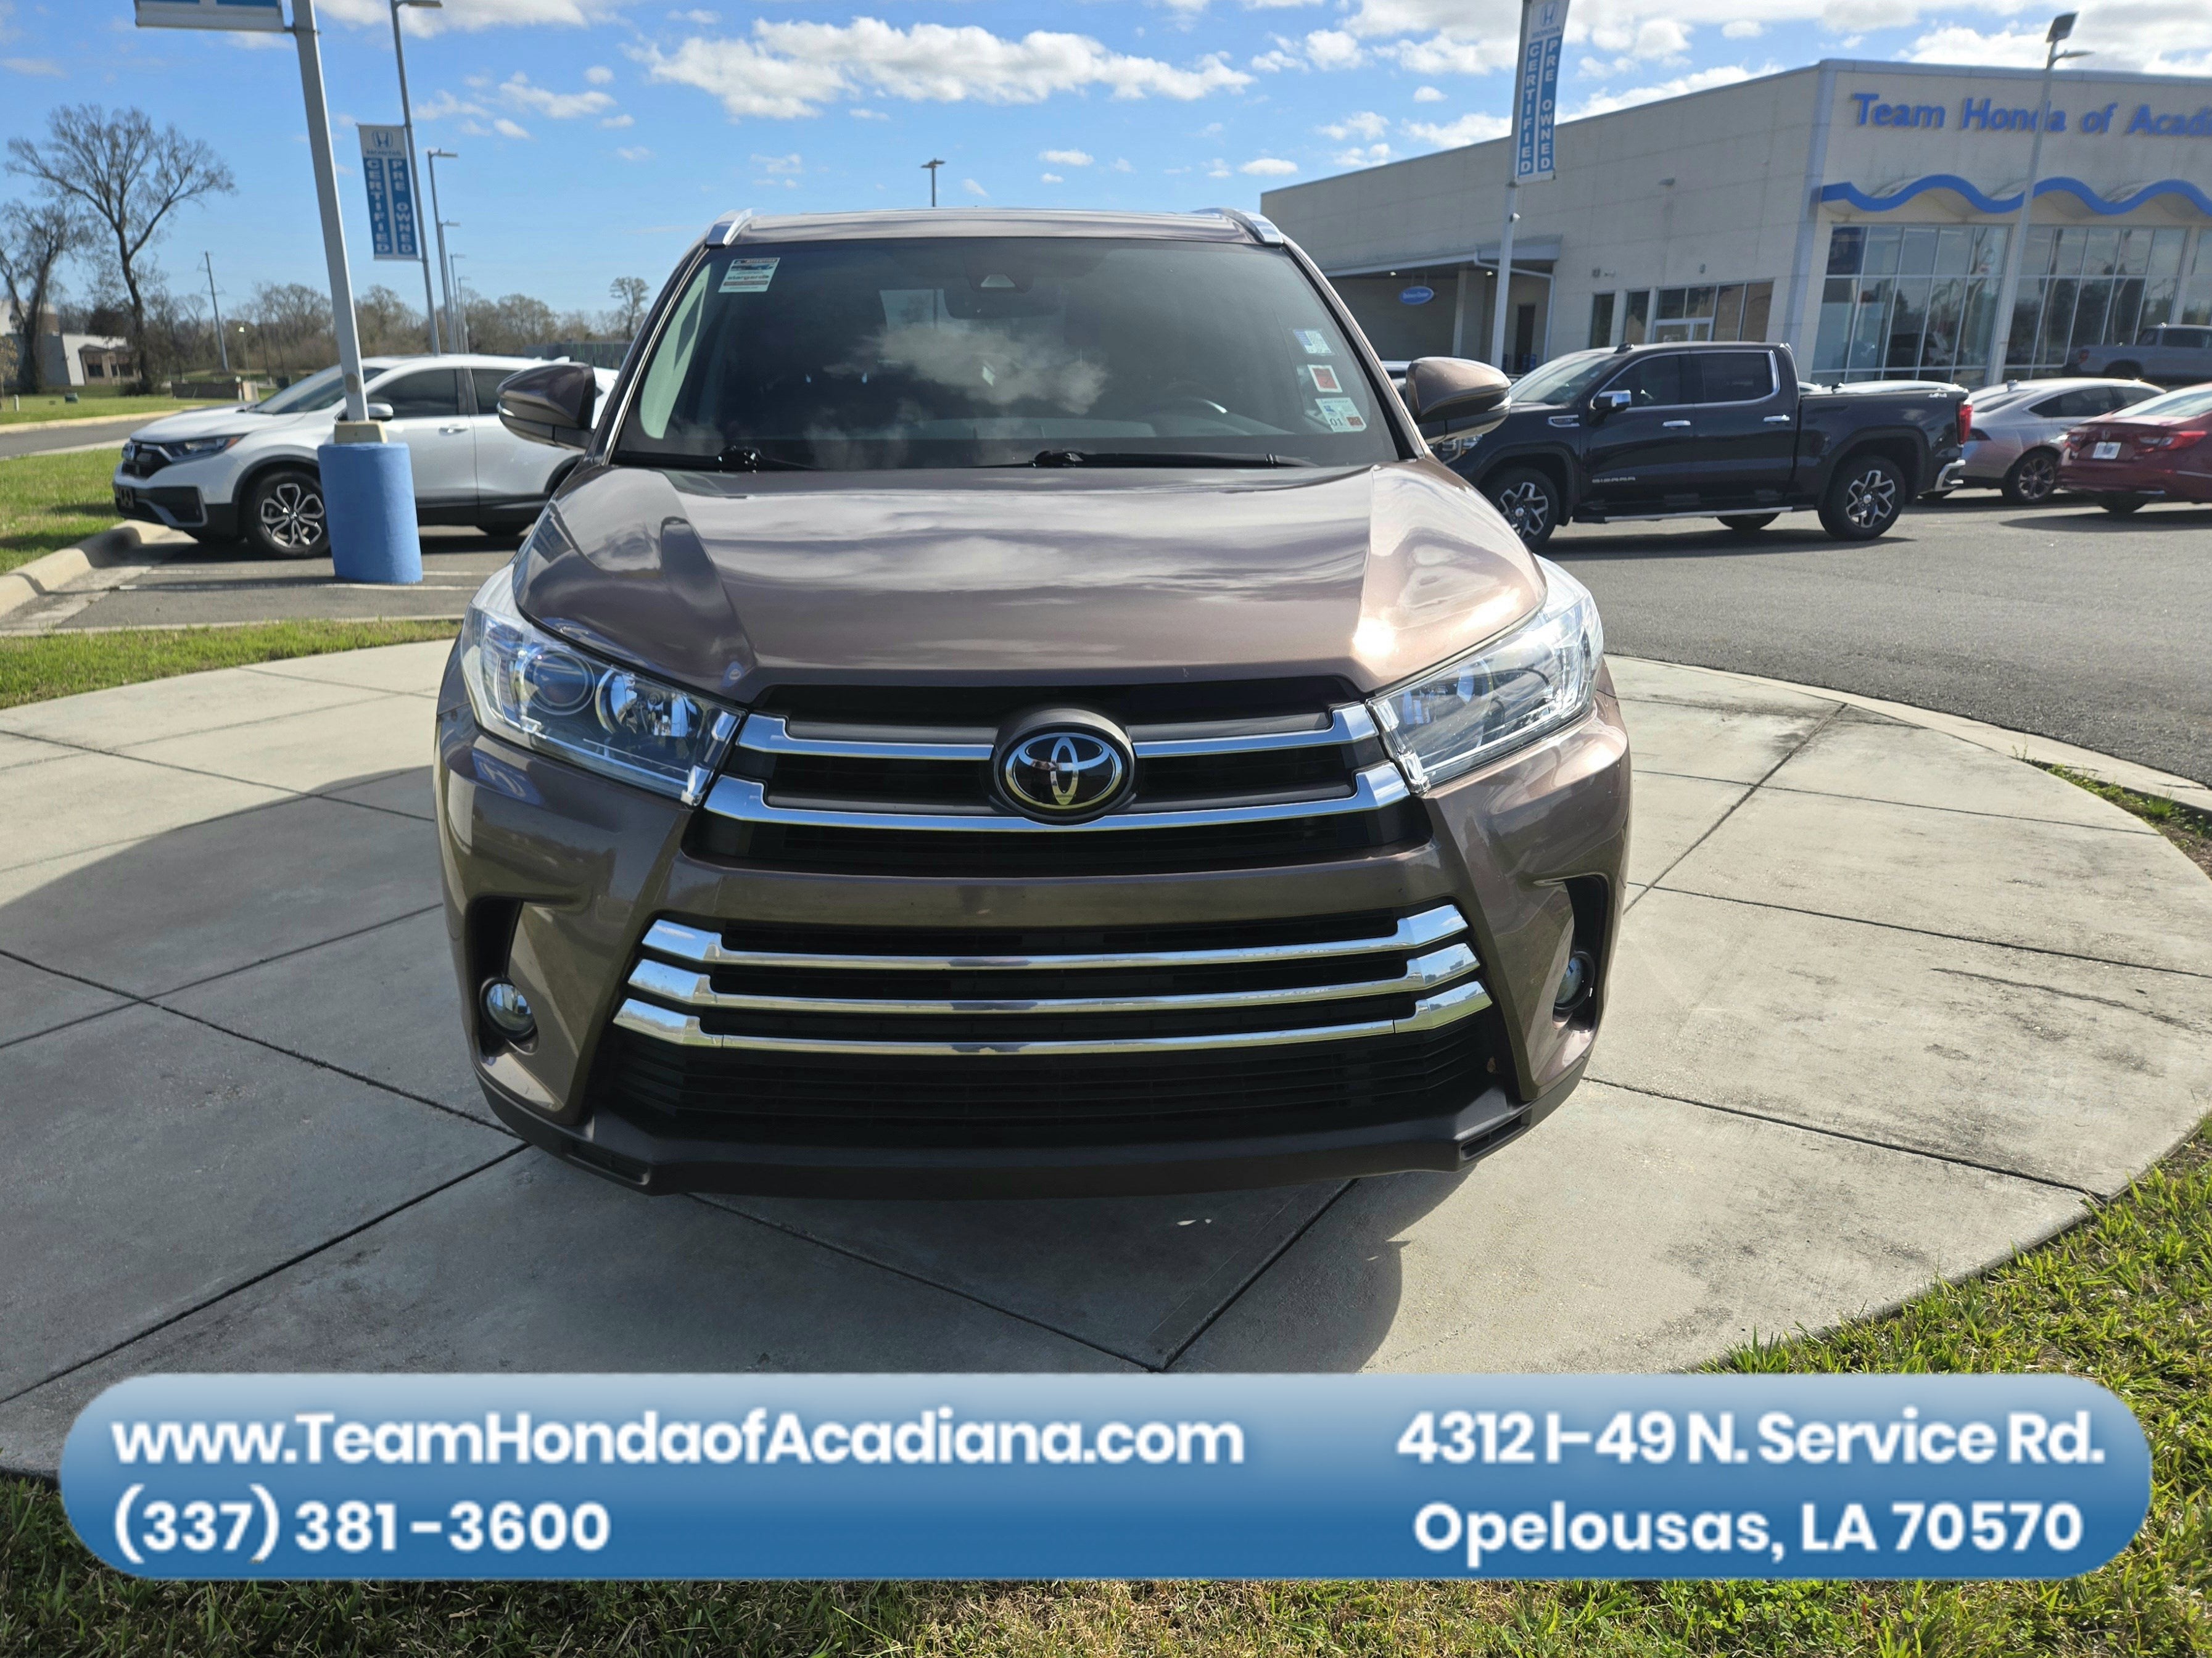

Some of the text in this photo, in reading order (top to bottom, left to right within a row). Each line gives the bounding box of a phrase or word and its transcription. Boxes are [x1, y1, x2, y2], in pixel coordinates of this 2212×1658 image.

[1519, 44, 1540, 173] CERTIFIED
[1540, 39, 1559, 169] PRE OWNED
[1852, 93, 1946, 128] Team
[1962, 97, 2066, 133] Honda
[2081, 102, 2118, 133] of
[366, 159, 390, 253] CERTIFIED
[392, 159, 413, 253] PRE OWNED
